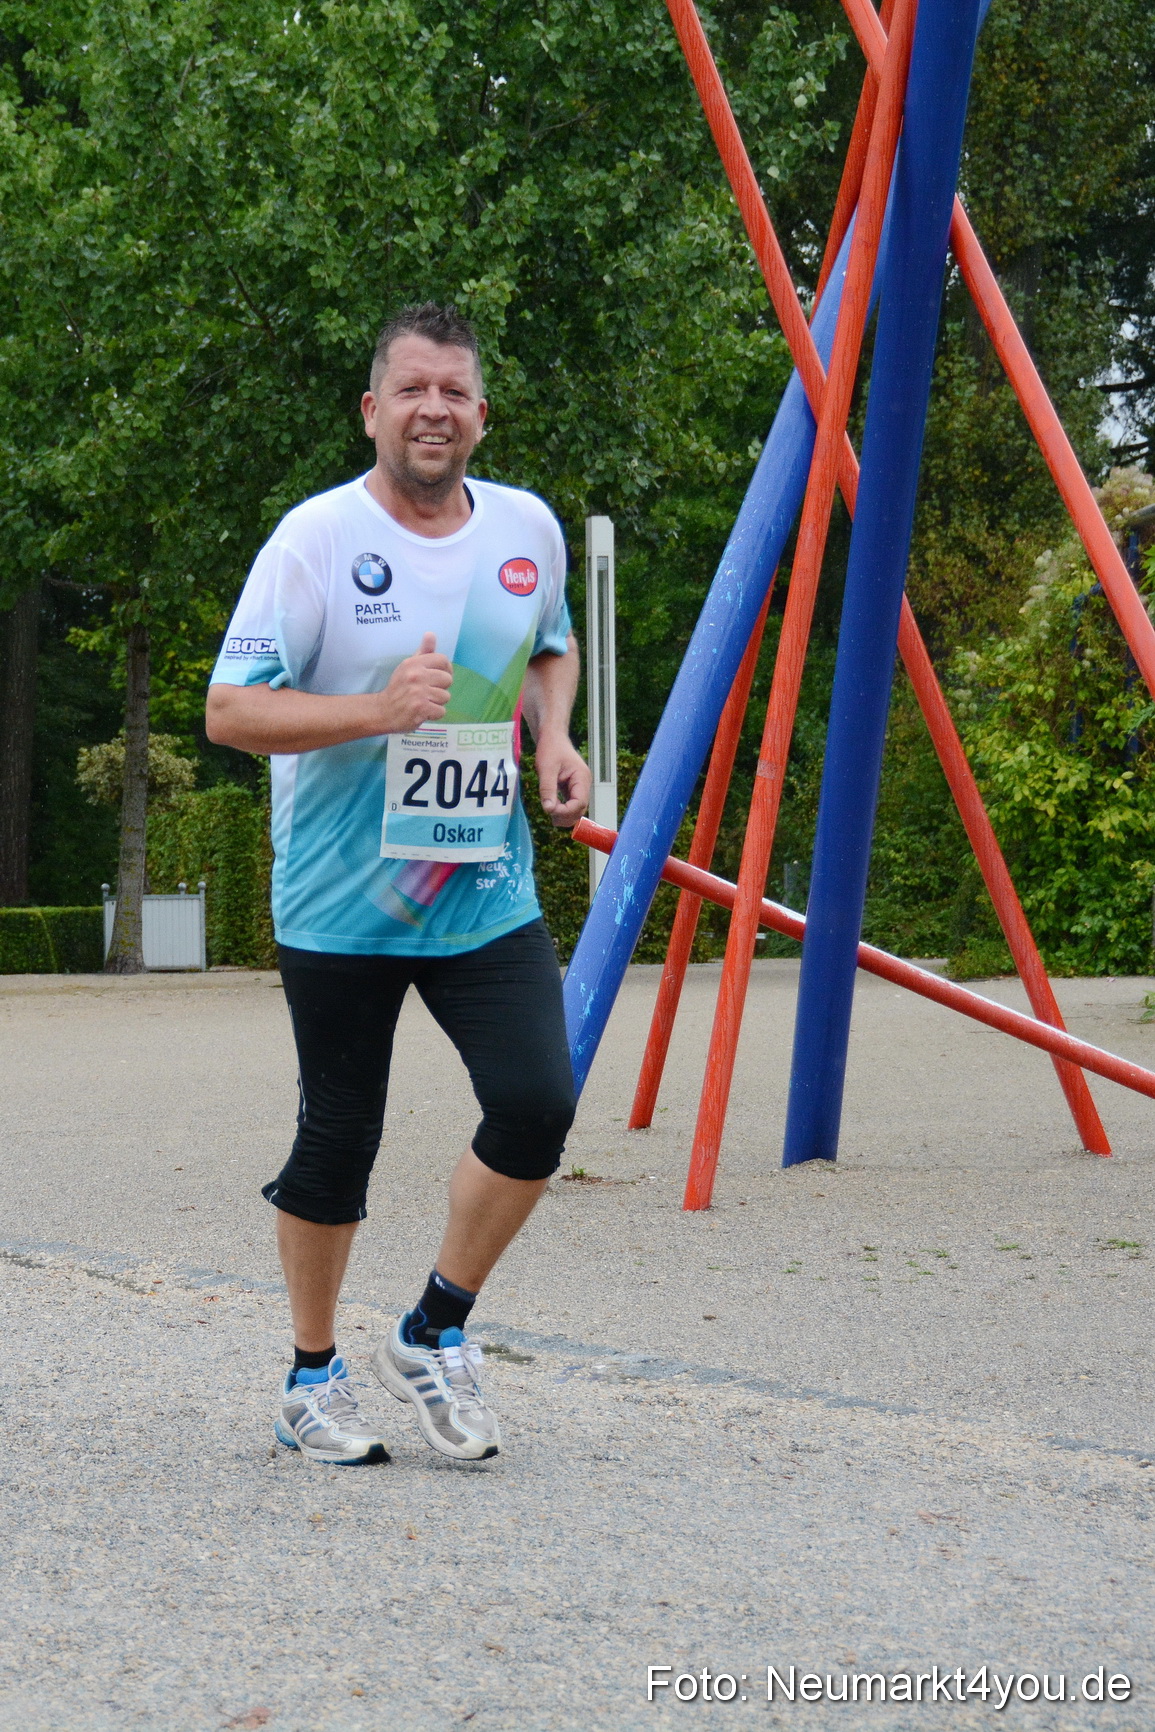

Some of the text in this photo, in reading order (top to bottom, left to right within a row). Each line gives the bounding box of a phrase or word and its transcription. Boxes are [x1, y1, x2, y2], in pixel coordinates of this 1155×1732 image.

[504, 568, 536, 587] Hervis
[355, 602, 400, 616] PARTL
[356, 614, 402, 625] Neumarkt
[401, 738, 449, 749] NeuerMarkt
[457, 728, 508, 747] BOCK
[402, 757, 510, 810] 2044
[391, 802, 398, 812] D
[433, 823, 484, 843] Oskar
